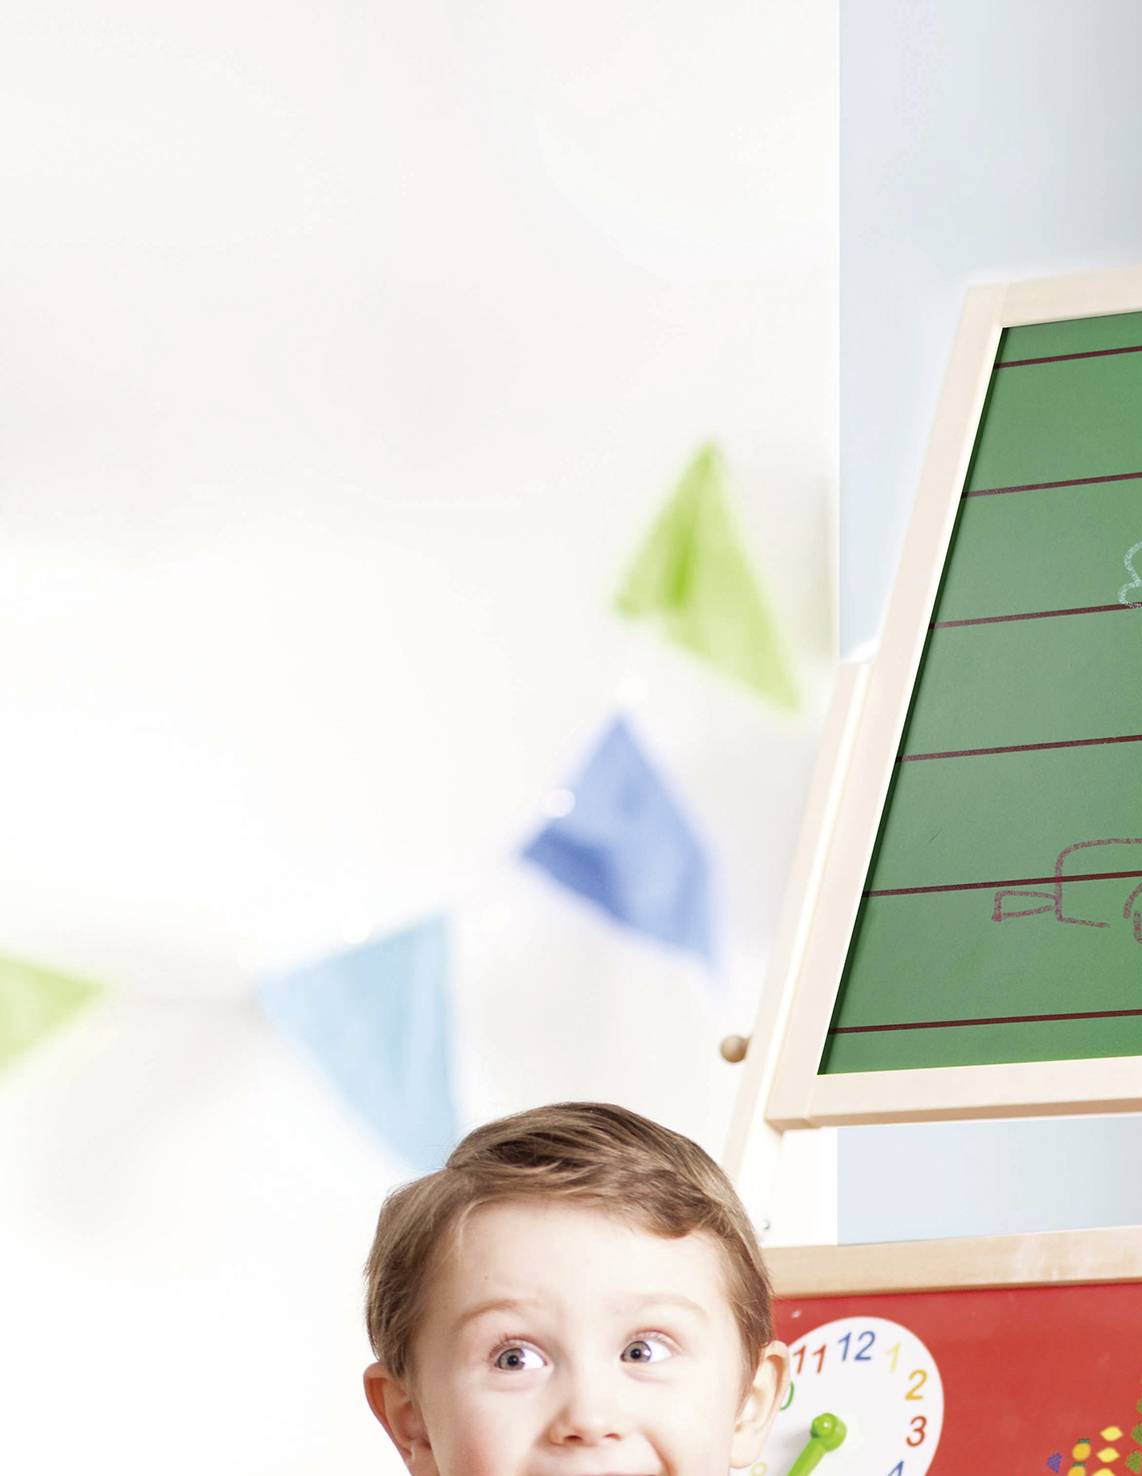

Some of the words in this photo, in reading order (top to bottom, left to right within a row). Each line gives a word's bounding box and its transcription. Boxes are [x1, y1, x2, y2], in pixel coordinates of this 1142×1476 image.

[792, 1344, 828, 1375] 11
[836, 1330, 877, 1362] 12
[886, 1343, 901, 1373] 1
[904, 1368, 928, 1402] 2
[905, 1415, 928, 1448] 3
